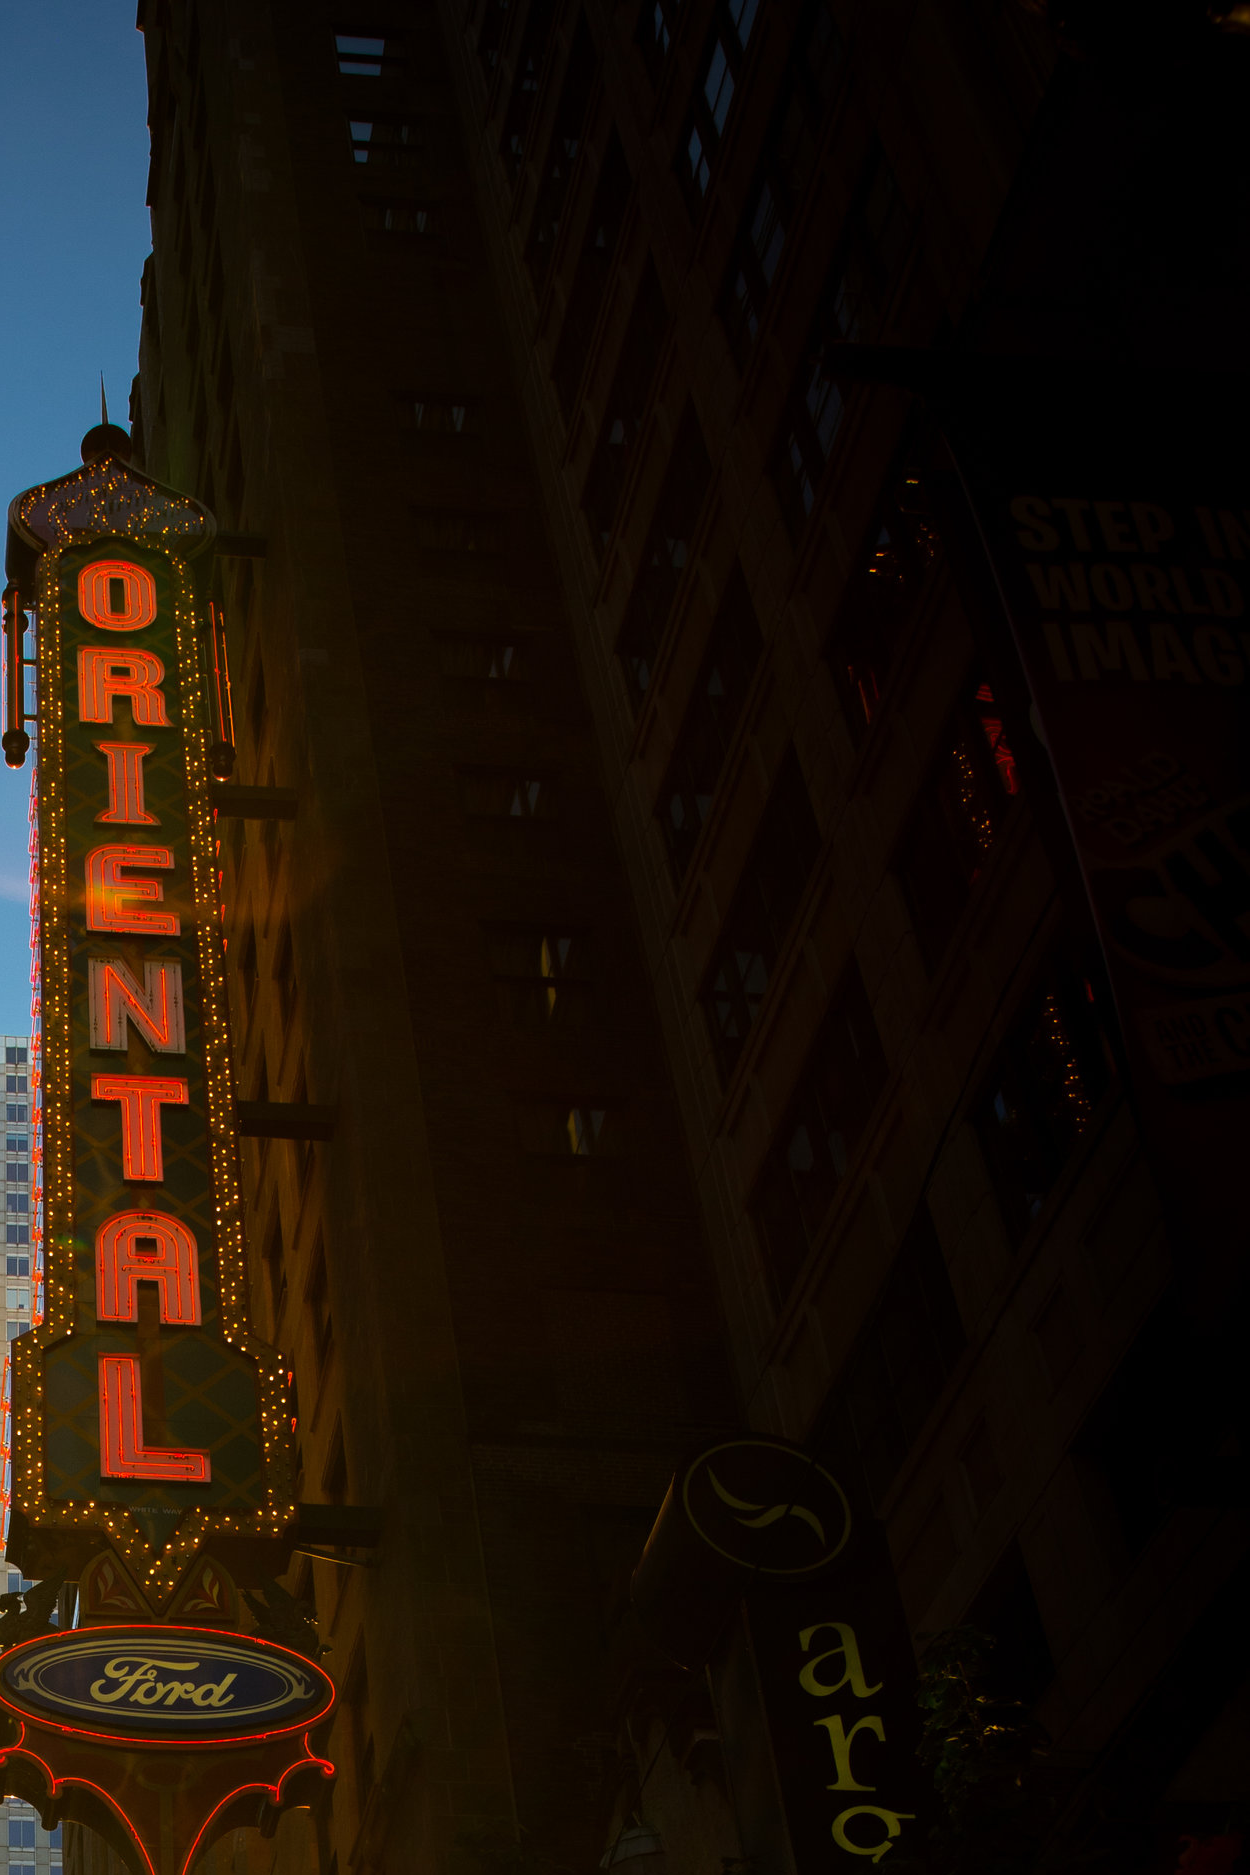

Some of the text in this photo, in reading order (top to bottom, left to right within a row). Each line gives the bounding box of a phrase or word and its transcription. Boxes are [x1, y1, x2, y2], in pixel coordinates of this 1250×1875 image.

[1010, 496, 1174, 552] STEP
[1025, 561, 1245, 616] WORLD
[77, 559, 212, 1483] ORIENTAL
[90, 1656, 238, 1708] Ford
